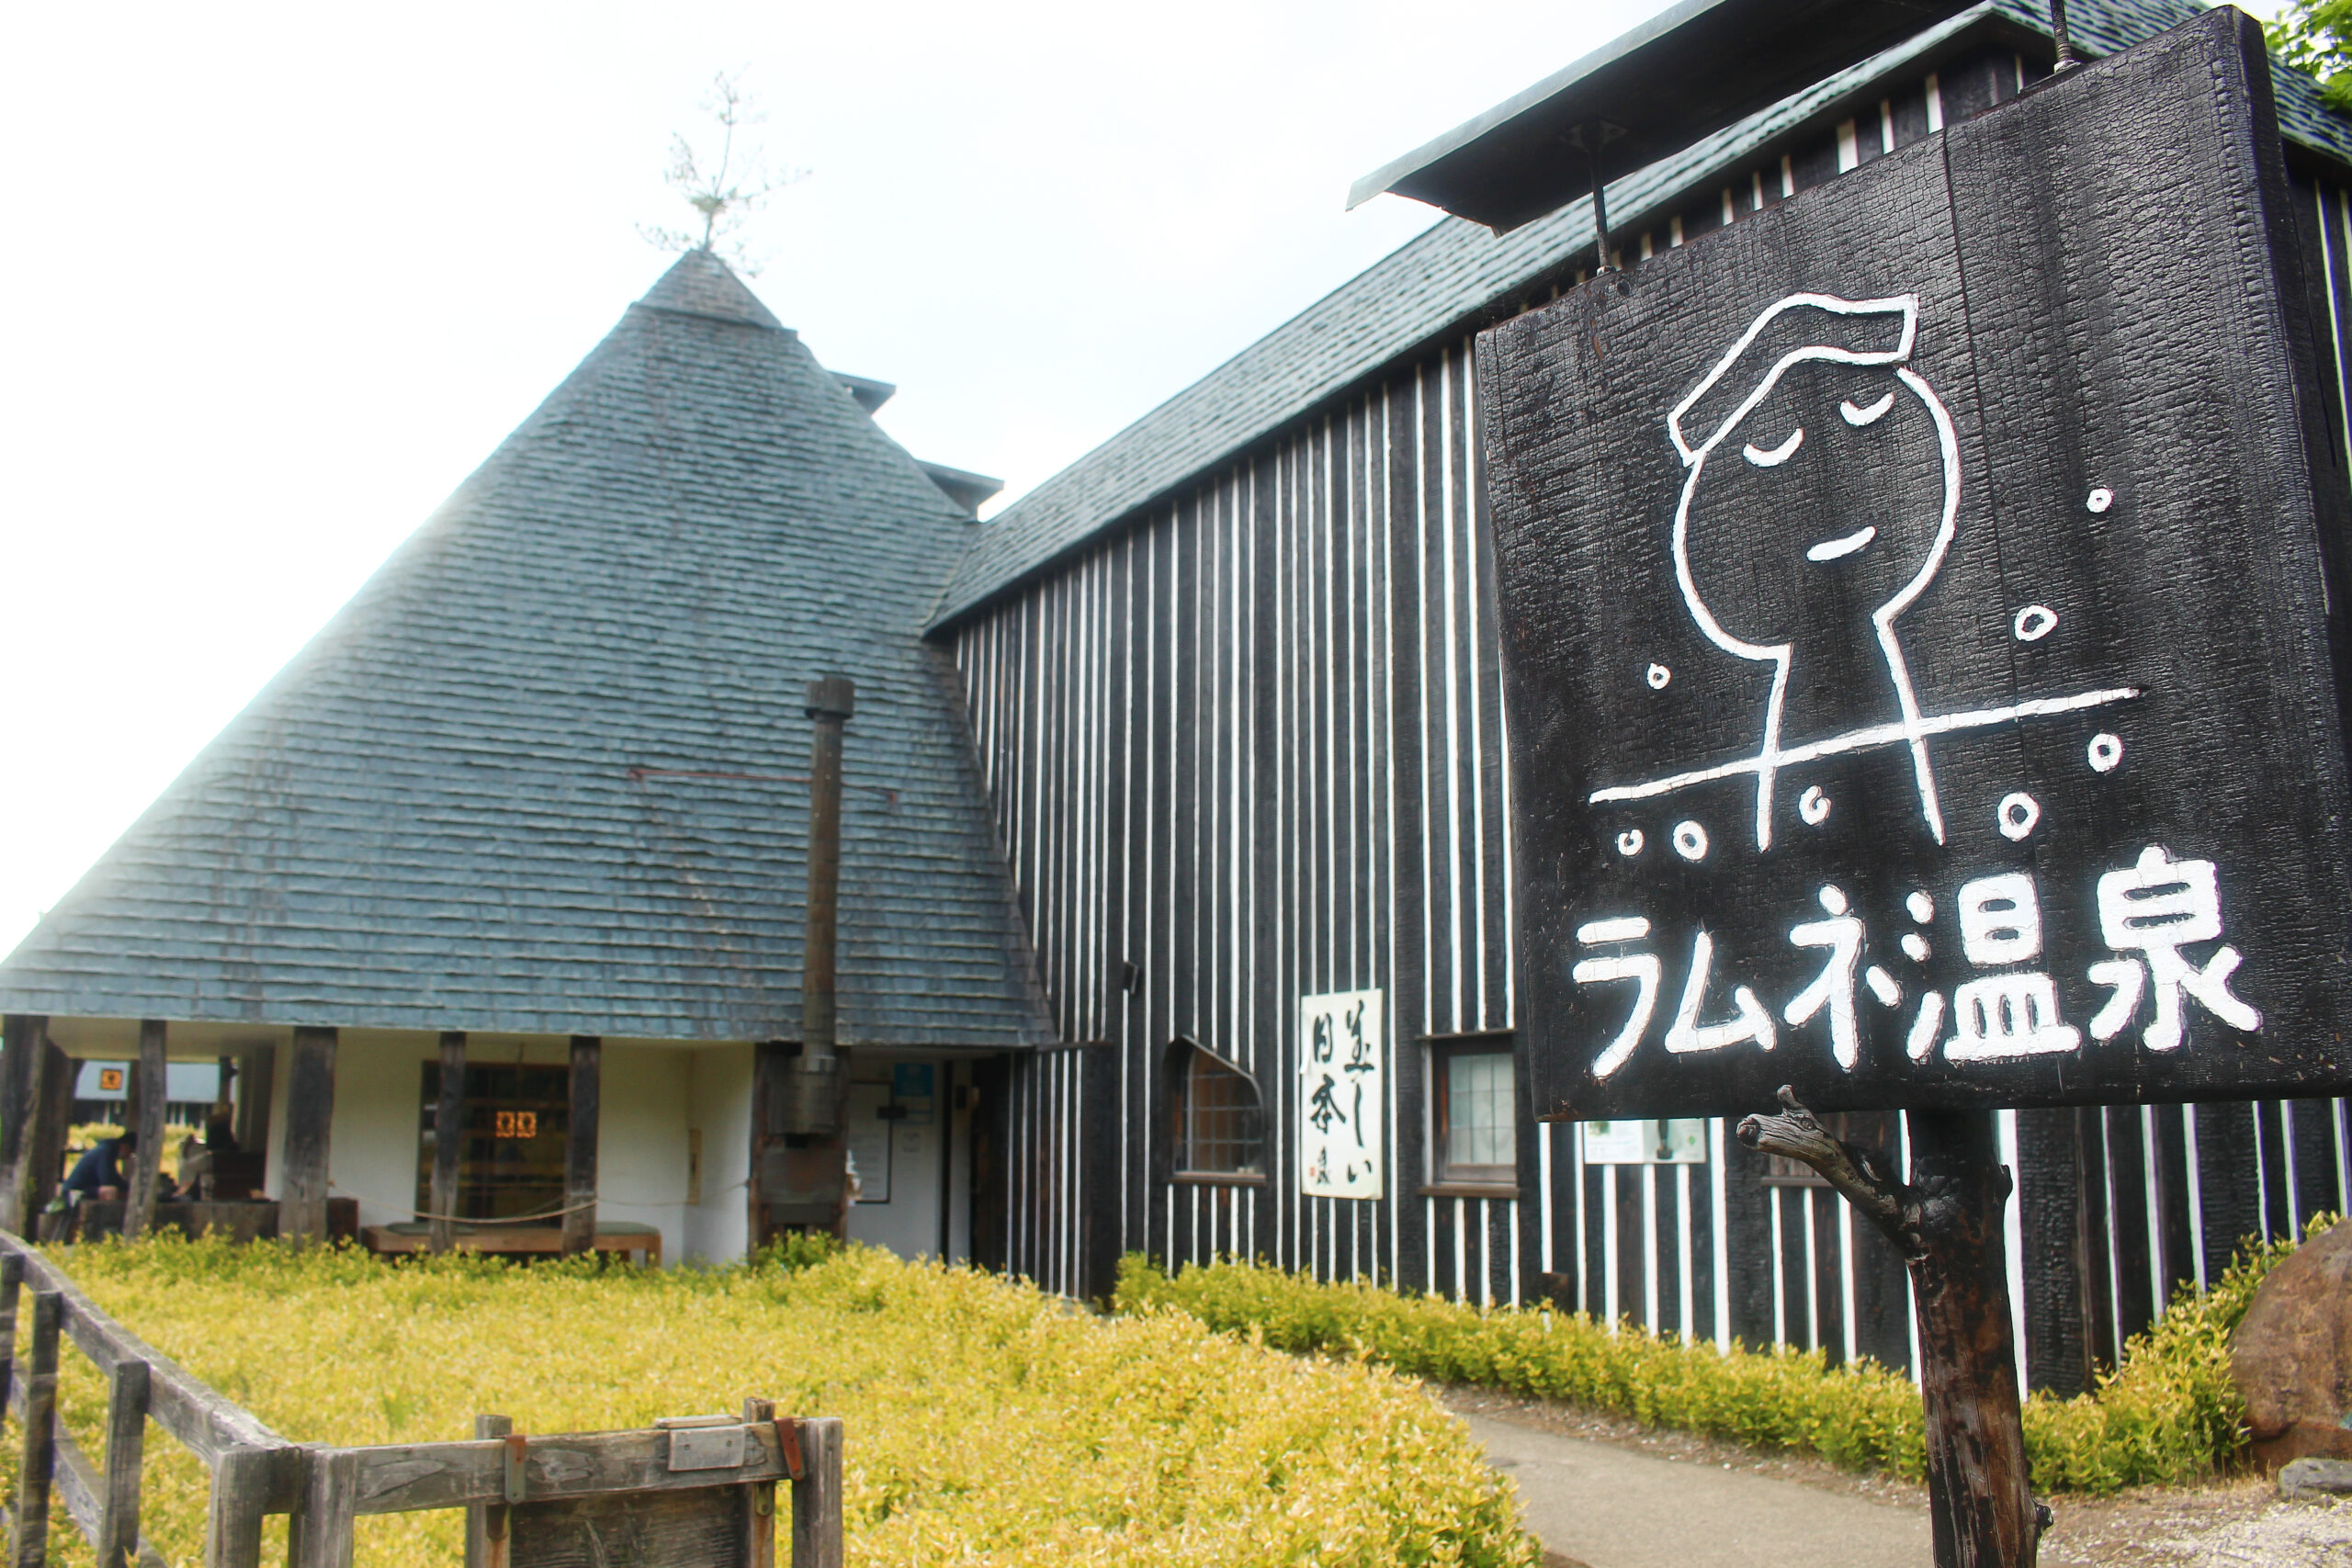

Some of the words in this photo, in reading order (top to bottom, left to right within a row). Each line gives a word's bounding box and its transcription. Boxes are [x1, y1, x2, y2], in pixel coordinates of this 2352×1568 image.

[1572, 845, 2263, 1080] ラムネ温泉
